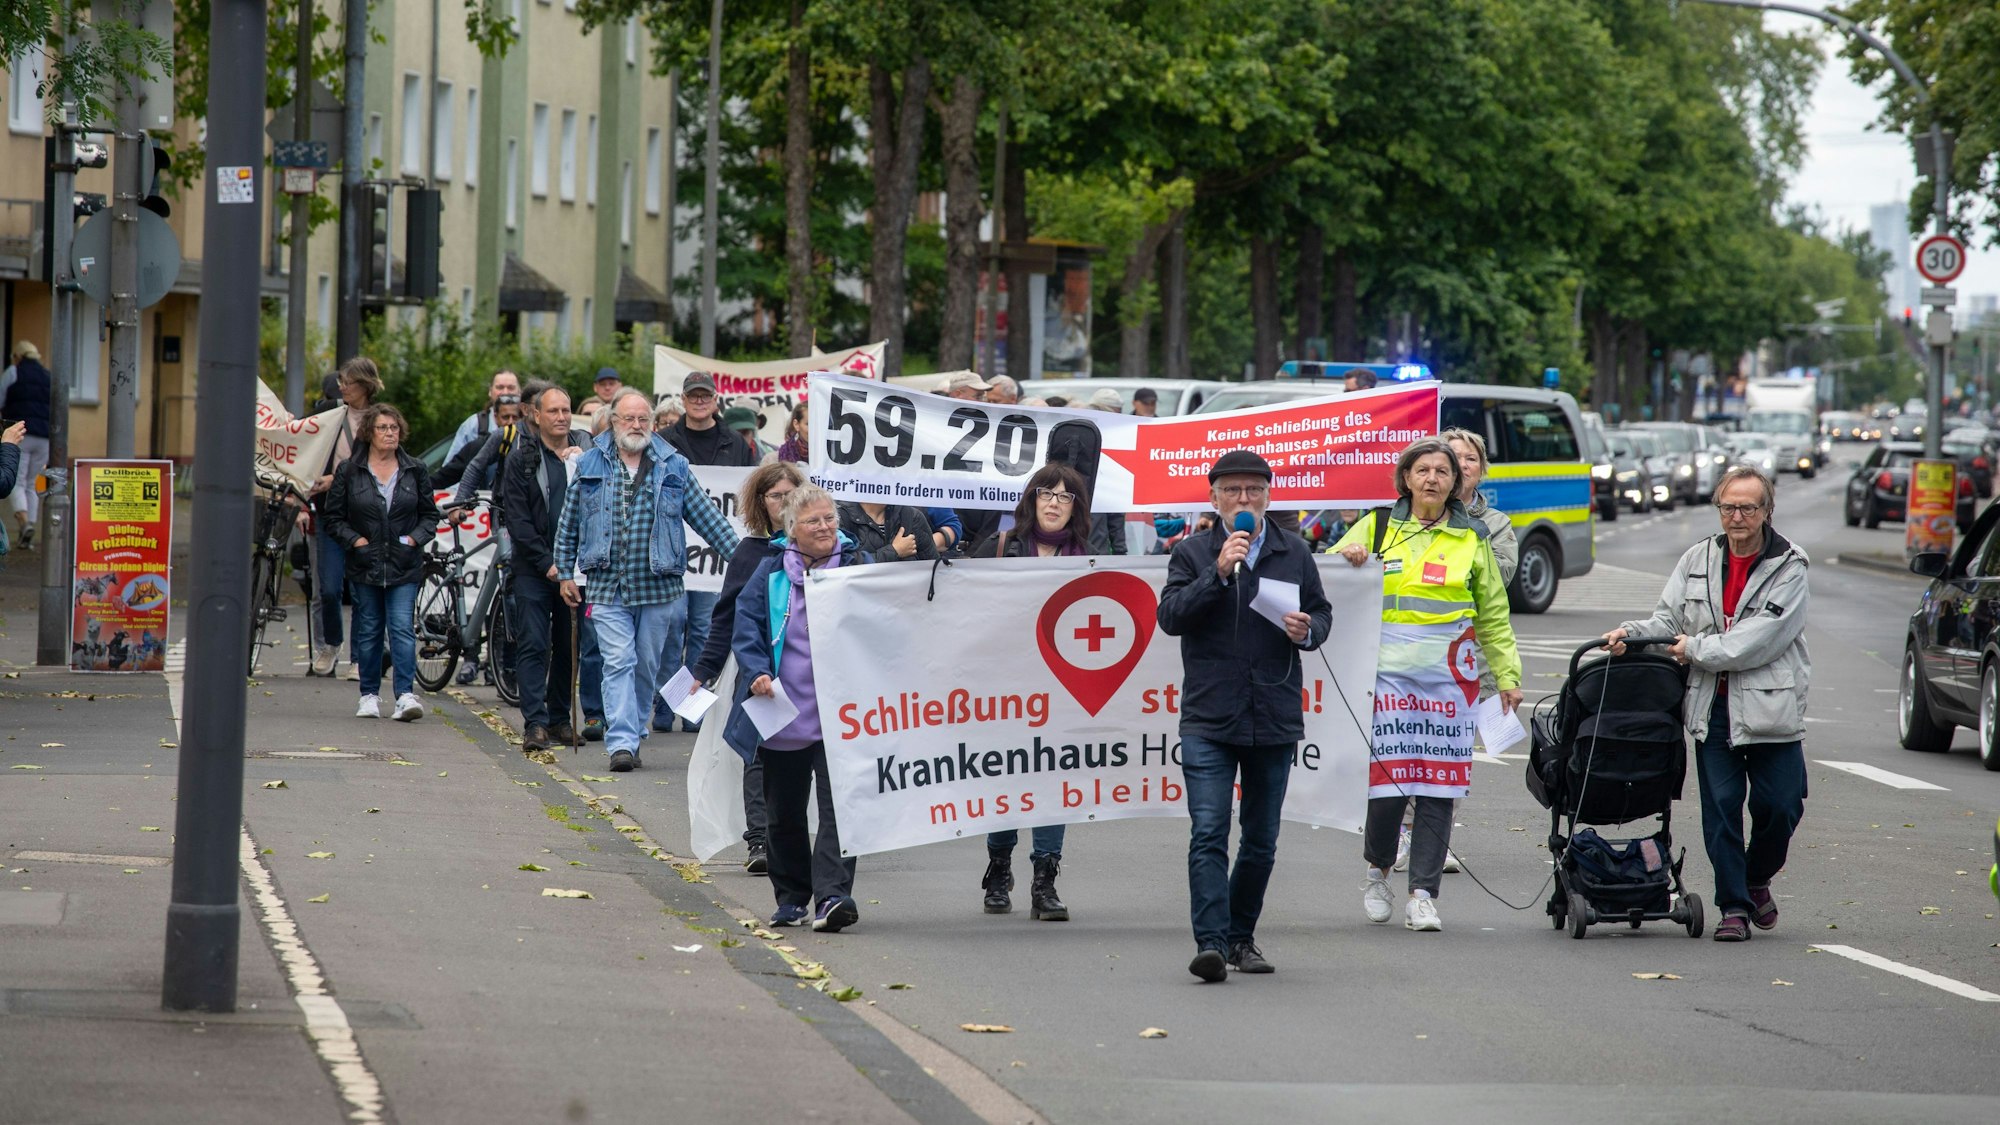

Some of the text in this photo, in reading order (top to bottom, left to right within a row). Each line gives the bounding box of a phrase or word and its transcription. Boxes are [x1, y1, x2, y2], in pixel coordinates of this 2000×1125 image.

[1926, 247, 1956, 271] 30
[826, 387, 1053, 477] 59.20
[1207, 410, 1372, 442] Keine Schließung des
[1323, 425, 1428, 446] Amsterdamer
[1168, 462, 1211, 477] Straß
[1289, 448, 1400, 466] Krankenhause
[95, 485, 113, 497] 30
[144, 486, 158, 497] 16
[895, 482, 944, 499] fordern
[948, 488, 975, 501] vom
[979, 486, 1022, 502] Kölner
[91, 536, 158, 552] Freizeitpark
[79, 561, 109, 572] Circus
[1423, 574, 1445, 584] ver.di
[838, 679, 1324, 740] Schließung stn!
[877, 736, 1128, 794] Krankenhaus
[1391, 763, 1458, 781] müssen
[930, 791, 1035, 825] muss
